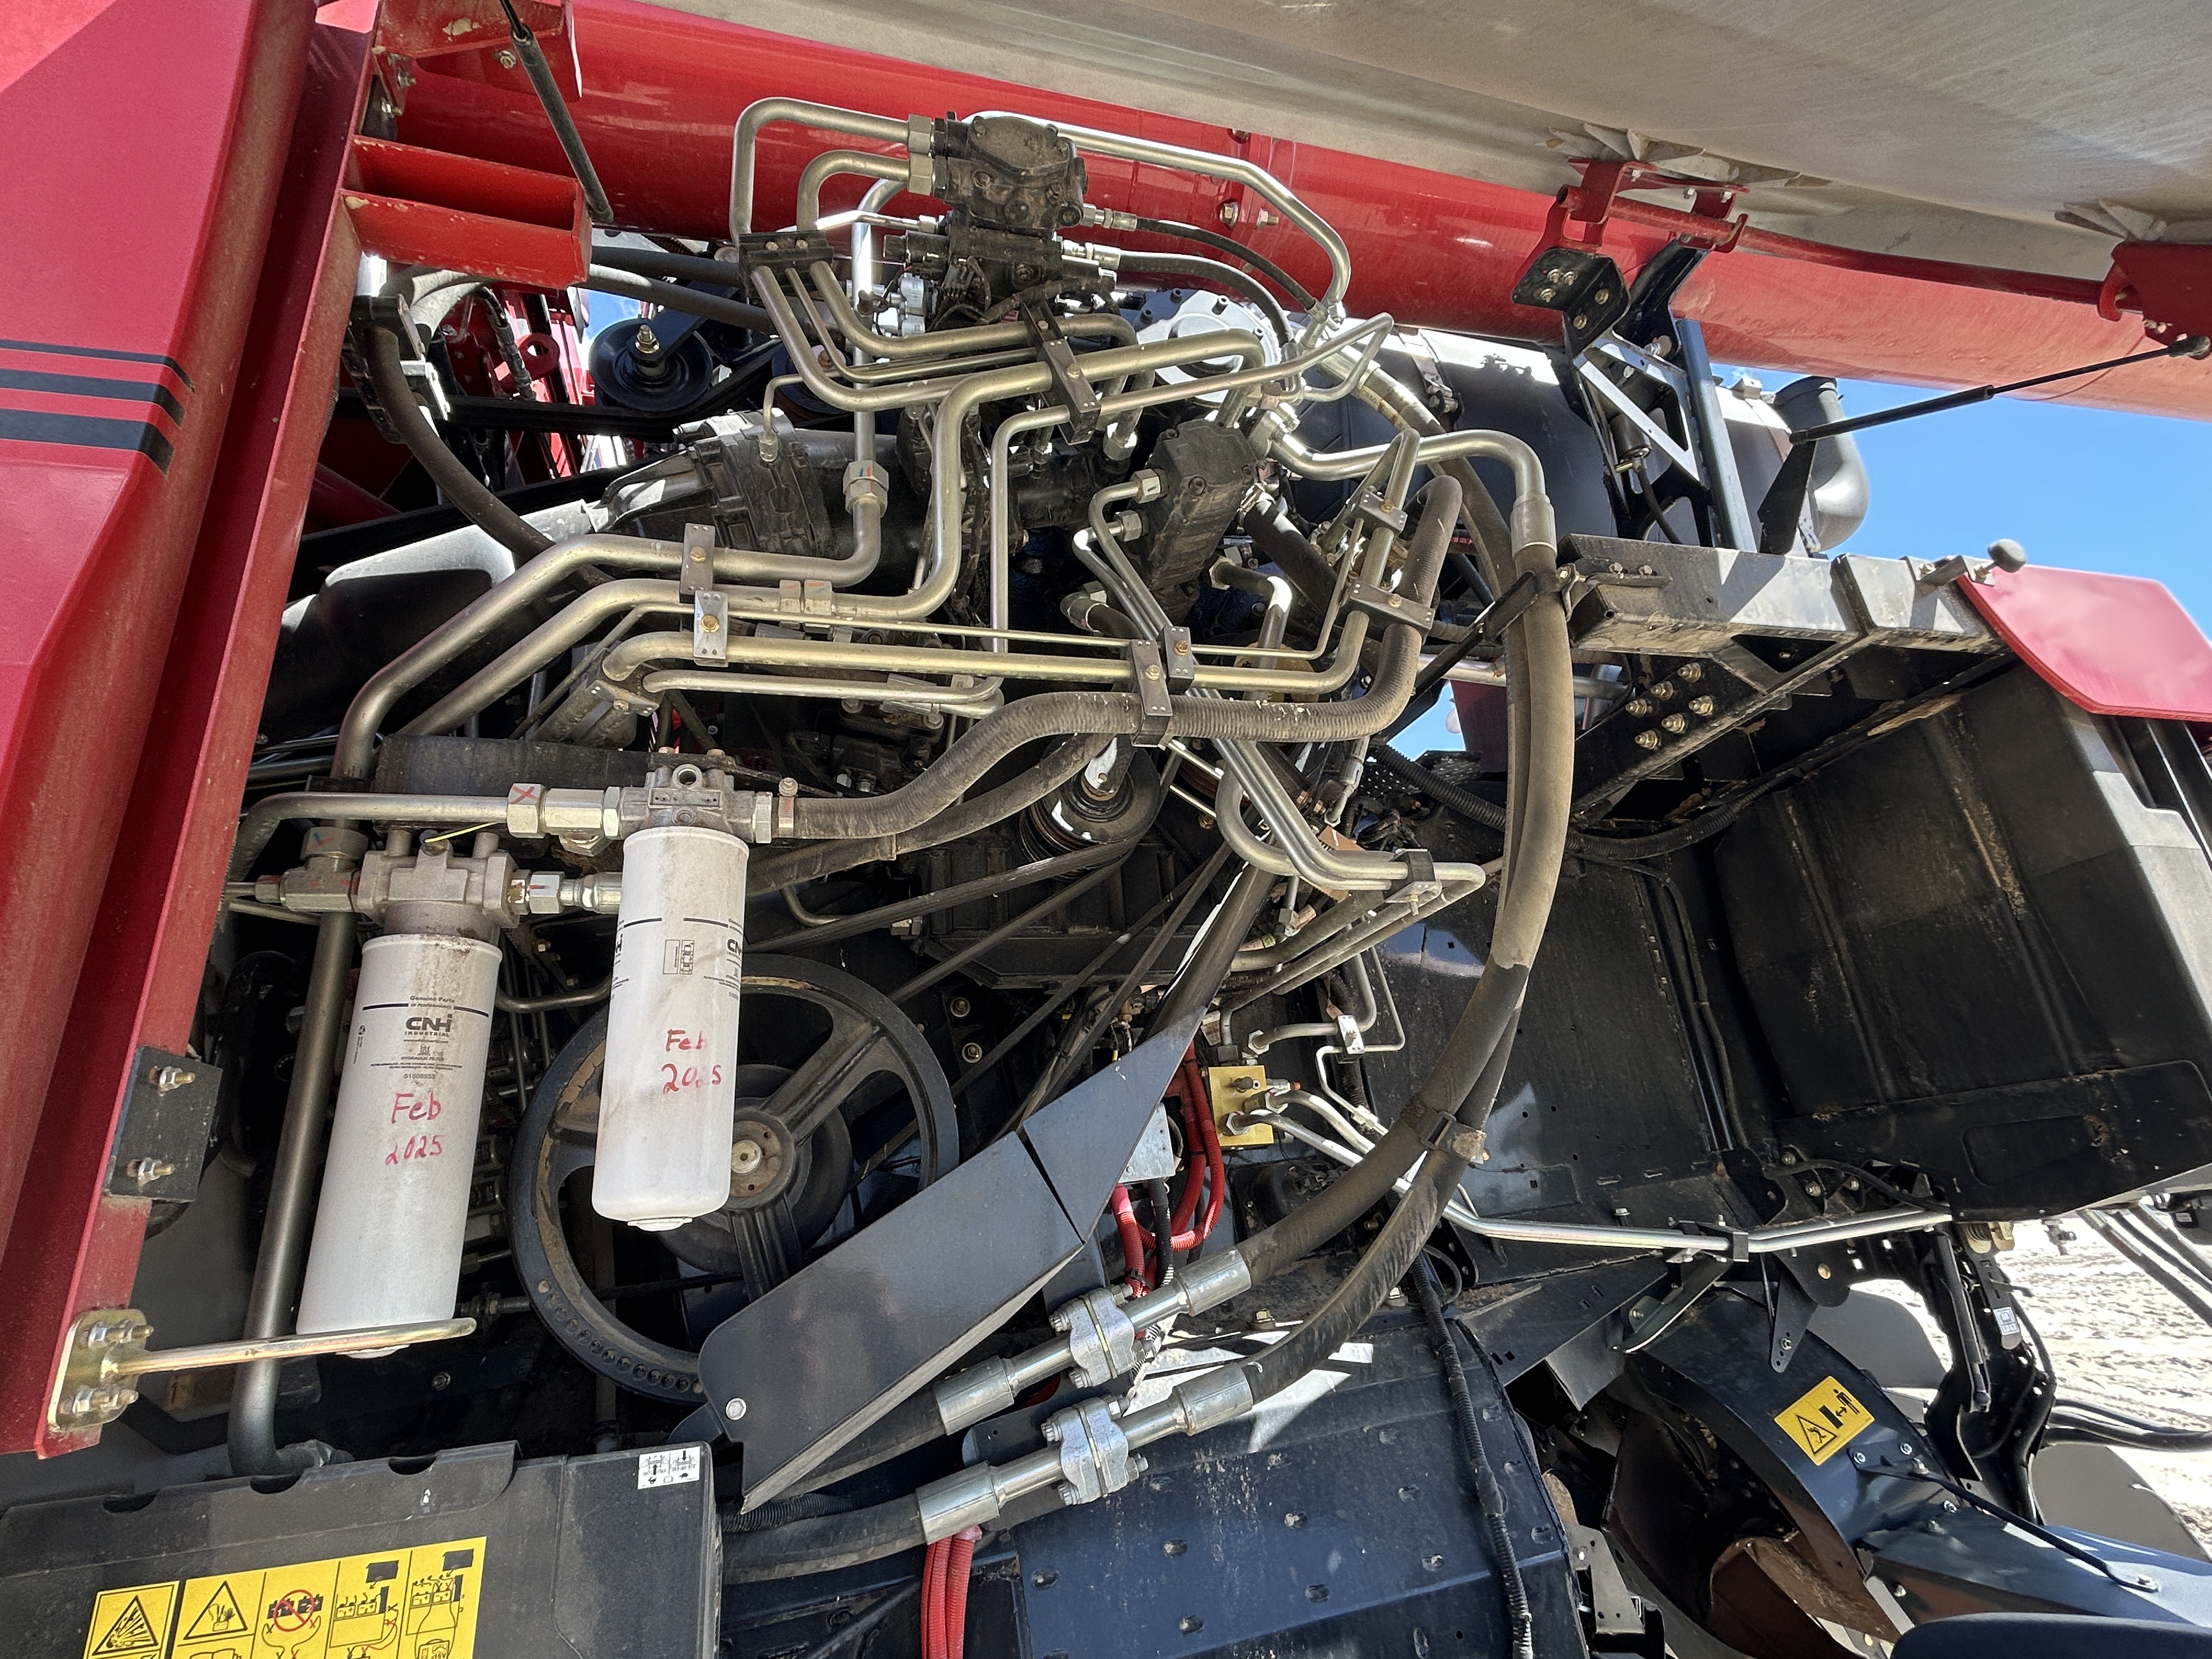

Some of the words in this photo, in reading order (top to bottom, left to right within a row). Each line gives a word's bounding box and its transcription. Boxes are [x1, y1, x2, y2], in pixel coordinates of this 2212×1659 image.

[661, 1063, 721, 1094] 205
[391, 1091, 442, 1124] Feb
[385, 1134, 446, 1166] 2025
